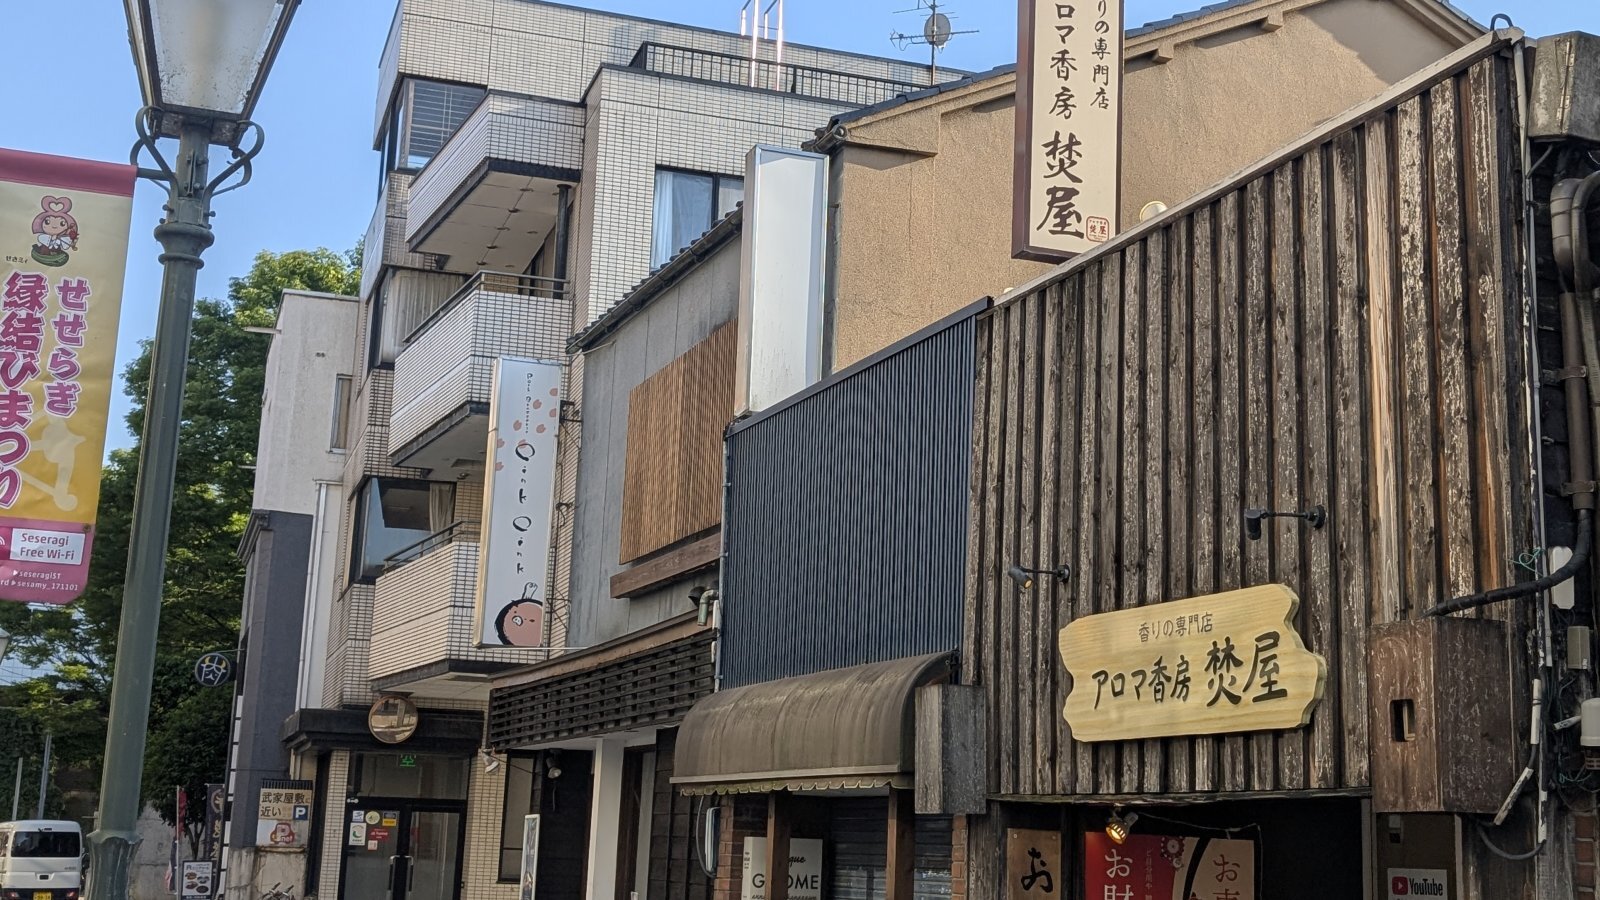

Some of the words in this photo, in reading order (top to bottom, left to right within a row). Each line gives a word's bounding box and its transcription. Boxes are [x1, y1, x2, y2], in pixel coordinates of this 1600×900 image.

[1049, 3, 1078, 120] ロマ香房
[1091, 0, 1111, 109] りの専門店
[1037, 131, 1084, 239] 焚屋
[45, 278, 90, 417] せせらぎ
[0, 271, 48, 508] 縁結びまつり
[515, 443, 536, 504] Oink
[20, 546, 44, 558] Free
[47, 548, 75, 560] Wi-Fi
[21, 532, 70, 548] Seseragi
[512, 515, 532, 575] Oink
[1138, 611, 1213, 643] 香りの専門店
[1091, 654, 1191, 710] アロマ香房
[1203, 630, 1288, 707] 焚屋
[260, 805, 282, 817] 近い
[295, 807, 306, 819] P
[752, 873, 819, 890] GME
[1409, 878, 1444, 897] YouTube
